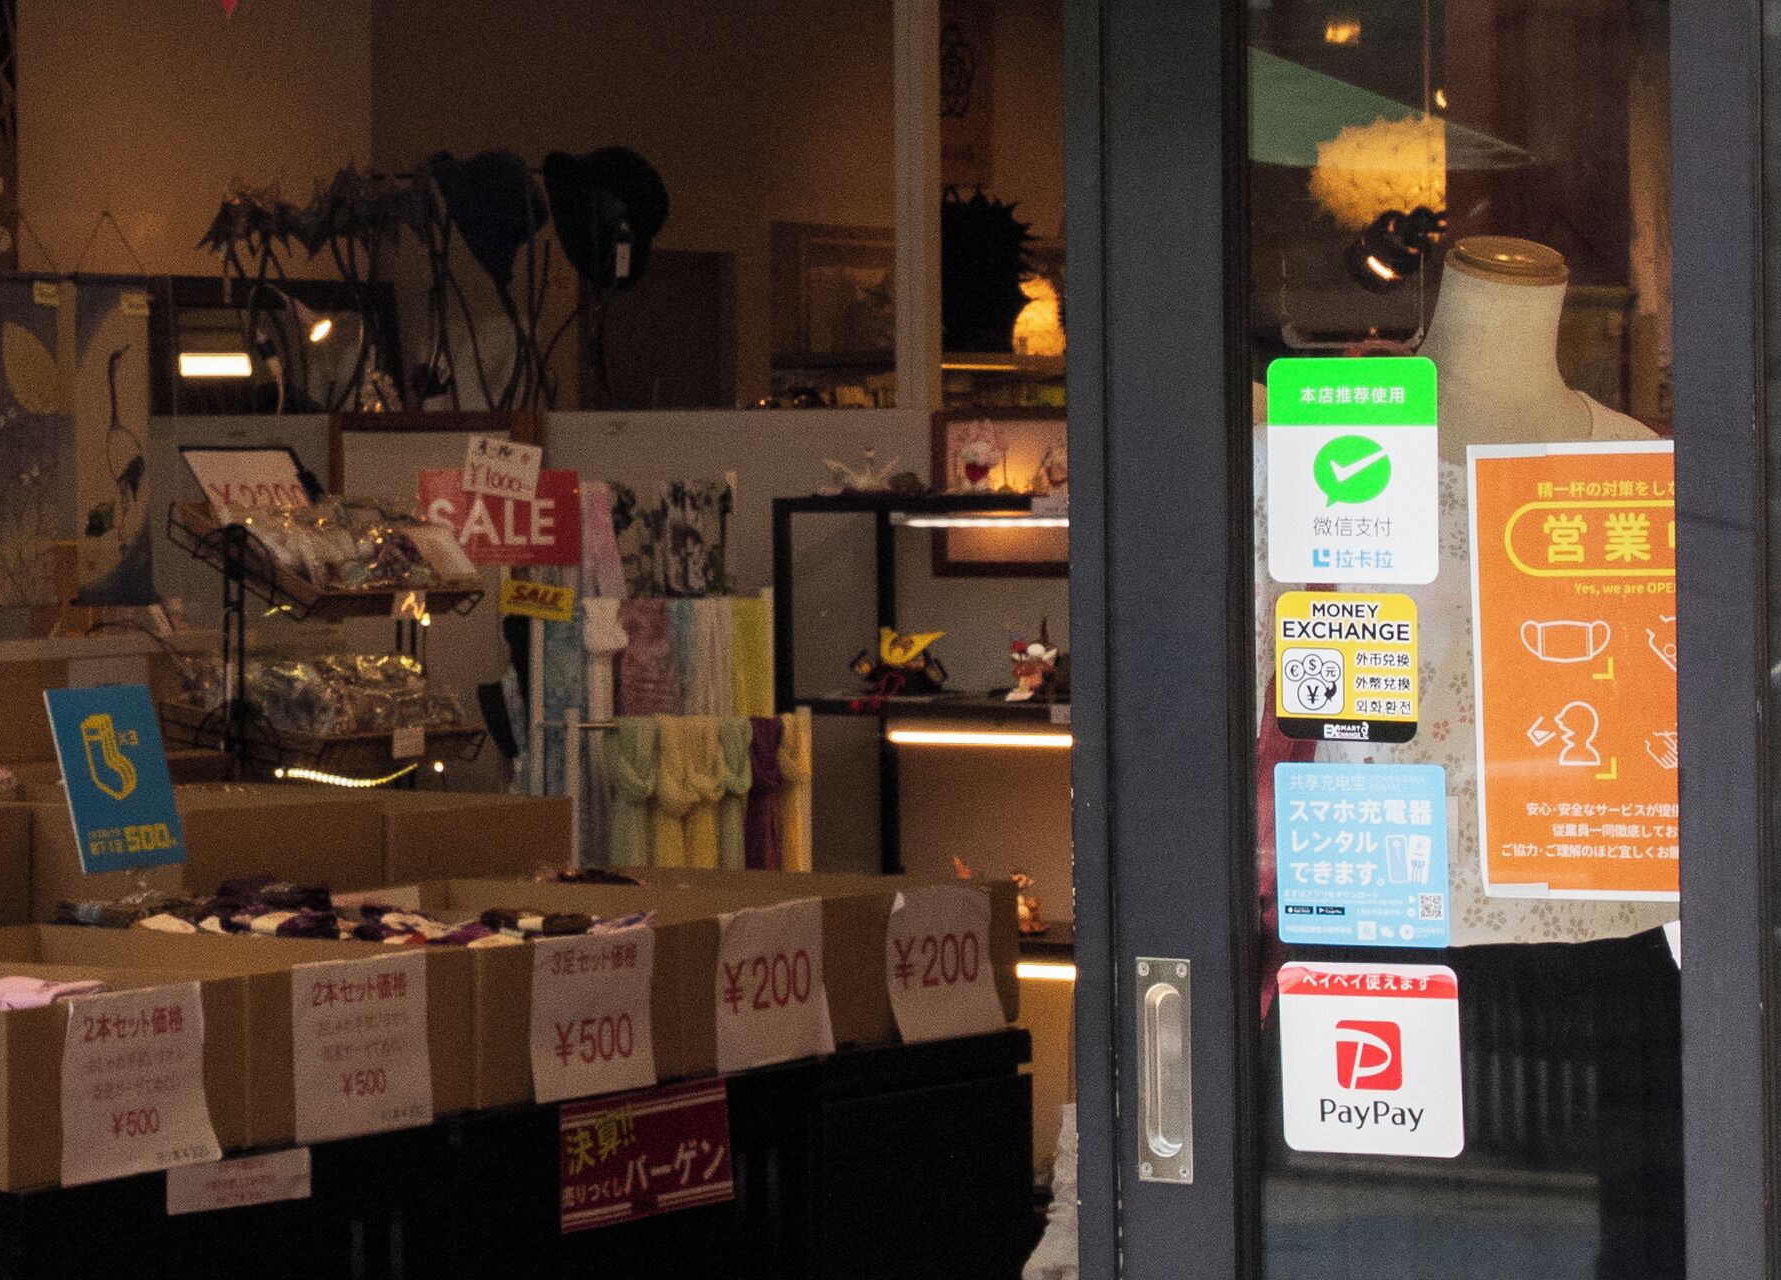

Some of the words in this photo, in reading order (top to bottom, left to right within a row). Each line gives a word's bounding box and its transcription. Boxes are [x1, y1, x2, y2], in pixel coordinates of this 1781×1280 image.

[1300, 387, 1405, 405] 本店推荐使用
[427, 493, 555, 546] SALE
[1313, 517, 1392, 537] 微信支付
[1543, 513, 1675, 563] 営業
[1335, 549, 1393, 569] 拉卡拉
[1574, 583, 1601, 596] Yes,
[1603, 584, 1621, 593] we
[1624, 584, 1645, 593] are
[1647, 582, 1675, 593] OPE
[1312, 603, 1379, 618] MONEY
[1283, 620, 1410, 641] EXCHANGE
[1356, 700, 1411, 715] 외화환전
[1289, 798, 1433, 826] スマホ充電器
[1291, 830, 1379, 853] レンタル
[1289, 860, 1385, 887] できます。
[893, 930, 979, 990] ¥200
[312, 972, 409, 1008] 2本セット価格
[723, 948, 812, 1015] ¥200
[83, 1006, 184, 1043] 2本セット価格
[554, 1012, 635, 1067] ¥500
[341, 1069, 387, 1097] ¥500
[111, 1107, 161, 1138] ¥500
[1319, 1098, 1425, 1132] PayPay
